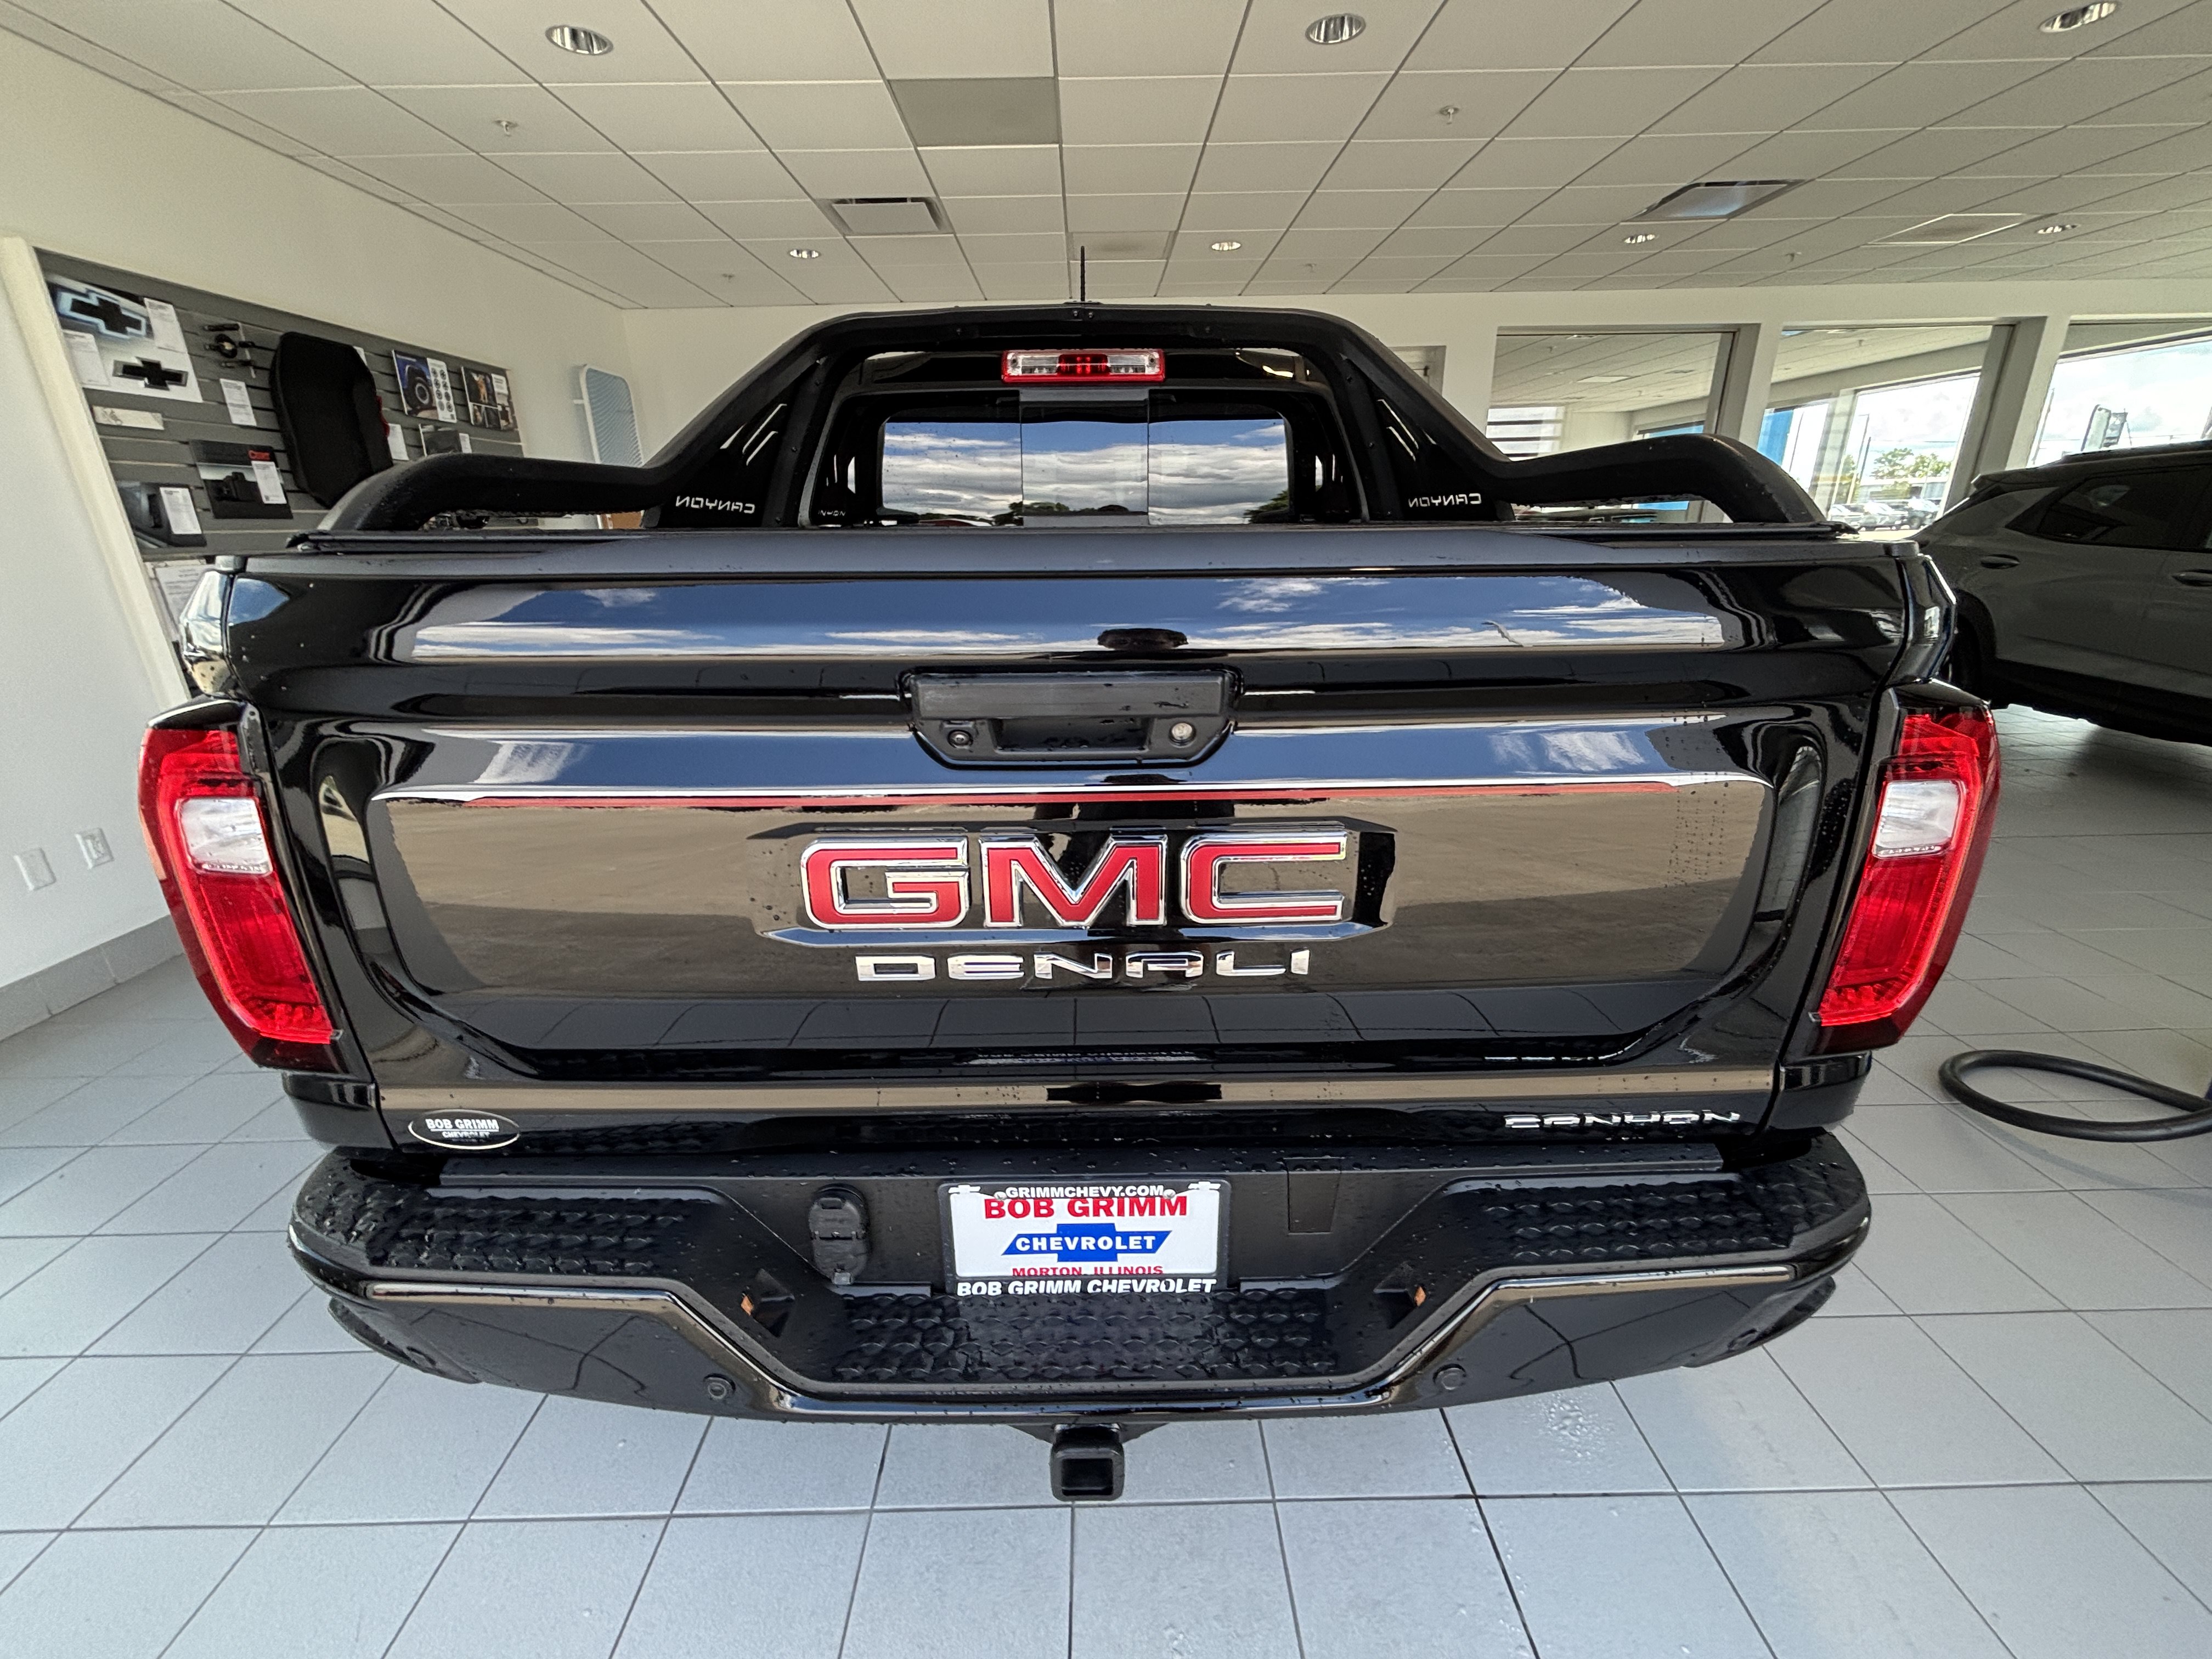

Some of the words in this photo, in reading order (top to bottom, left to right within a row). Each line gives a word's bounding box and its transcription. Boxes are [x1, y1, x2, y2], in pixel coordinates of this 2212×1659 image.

[800, 832, 1347, 929] GMC
[855, 949, 1310, 982] DENALI
[425, 1119, 453, 1129] BOB
[455, 1119, 499, 1130] GRIMM
[1504, 1110, 1741, 1128] CANYON
[1005, 1185, 1164, 1199] GRIMMCHEVY.COM
[984, 1198, 1055, 1219] BOB
[1067, 1196, 1188, 1218] GRIMM
[1016, 1235, 1156, 1251] CHEVROLET
[957, 1280, 1002, 1296] BOB
[1008, 1279, 1081, 1295] GRIMM
[1087, 1278, 1217, 1294] CHEVROLET
